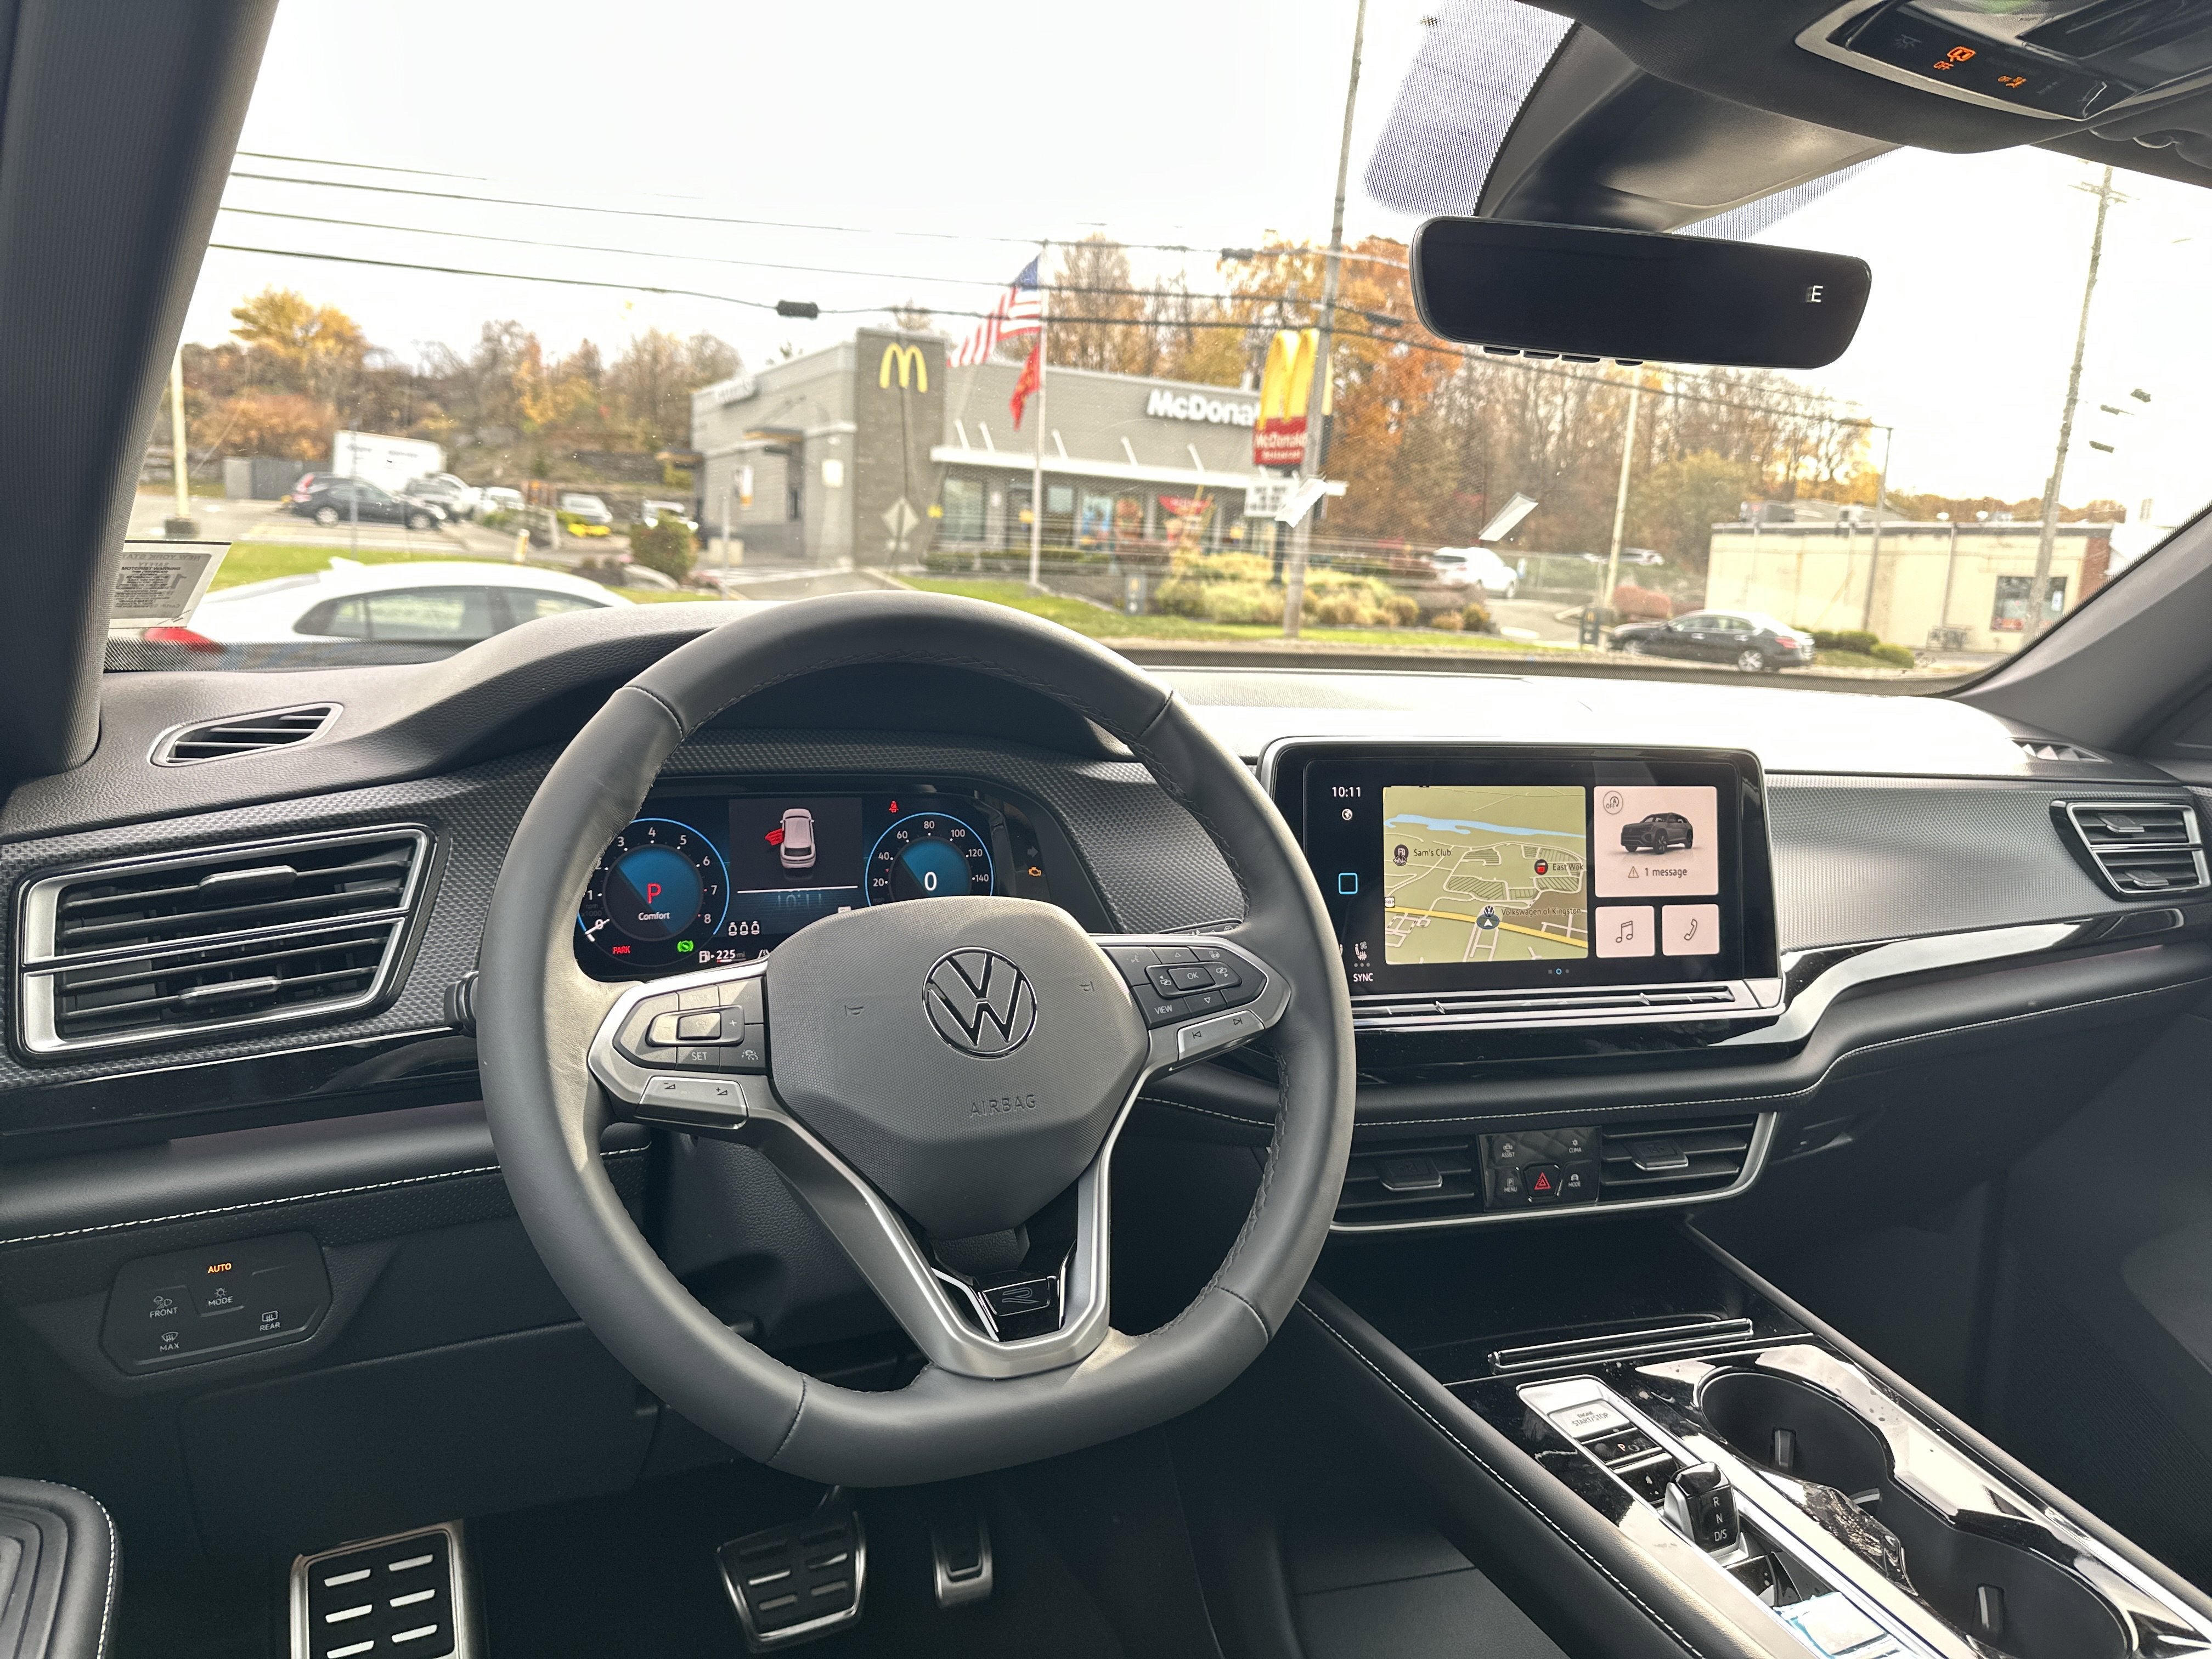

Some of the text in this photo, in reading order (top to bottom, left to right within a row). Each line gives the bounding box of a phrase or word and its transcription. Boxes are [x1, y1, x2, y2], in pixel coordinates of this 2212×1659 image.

[1811, 285, 1823, 302] E
[1332, 786, 1361, 797] 10:11
[923, 821, 935, 829] 80
[648, 827, 656, 837] 4
[896, 831, 908, 839] 60
[951, 829, 966, 837] 100
[617, 837, 624, 847] 3
[680, 835, 687, 845] 5
[878, 851, 890, 860] 40
[968, 849, 983, 857] 120
[703, 856, 710, 866] 6
[975, 873, 989, 882] 140
[1645, 868, 1687, 878] 1 message
[873, 878, 885, 887] 20
[924, 871, 937, 891] 0
[587, 890, 593, 900] 1
[647, 883, 662, 904] P
[711, 885, 718, 895] 7
[638, 912, 670, 921] Comfort
[1501, 908, 1541, 916] Volkswagen
[1551, 907, 1581, 916] Kingston
[704, 913, 711, 924] 8
[595, 919, 604, 930] 0
[613, 945, 631, 955] PARK
[716, 949, 736, 959] 225
[1187, 971, 1199, 980] OK
[1353, 973, 1374, 982] SYNC
[1154, 1005, 1173, 1014] VIEW
[691, 1052, 707, 1060] SET
[970, 1094, 1036, 1118] AIRBAG
[207, 1262, 232, 1274] AUTO
[208, 1295, 233, 1307] MODE
[149, 1306, 178, 1319] FRONT
[259, 1322, 281, 1332] REAR
[160, 1342, 180, 1352] MAX
[1572, 1412, 1609, 1426] START/STOP
[1577, 1410, 1593, 1419] ENGINE
[1713, 1496, 1720, 1508] R
[1716, 1514, 1723, 1523] N
[1714, 1529, 1727, 1542] D/S
